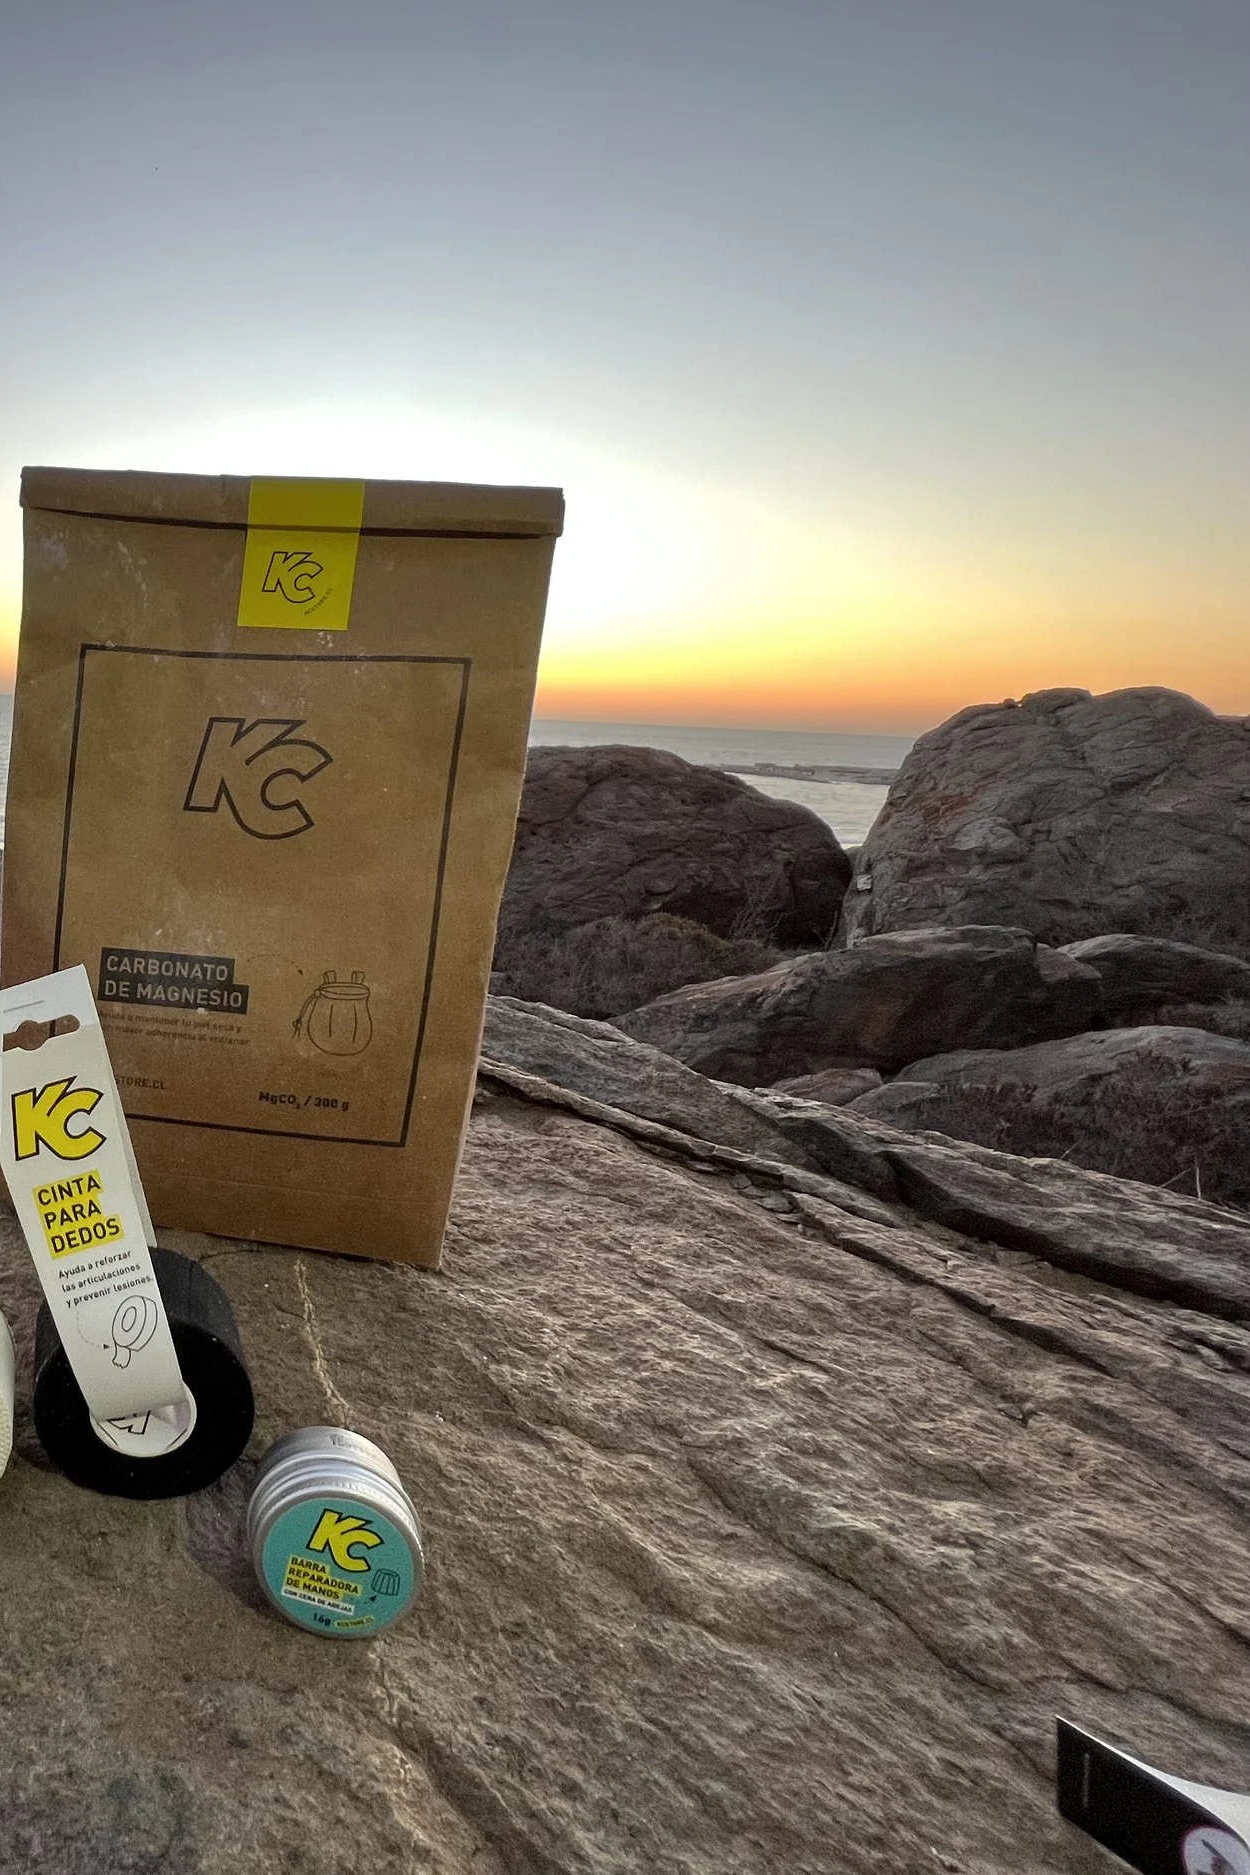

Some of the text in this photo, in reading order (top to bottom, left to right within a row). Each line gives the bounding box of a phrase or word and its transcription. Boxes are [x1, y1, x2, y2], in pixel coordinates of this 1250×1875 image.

[261, 551, 324, 604] KC
[183, 716, 334, 840] KC
[106, 955, 229, 981] CARBONATO
[104, 980, 242, 1008] DE MAGNESIO
[11, 1075, 107, 1161] KC
[303, 1095, 311, 1107] /
[314, 1097, 338, 1109] 300
[341, 1101, 350, 1113] g
[37, 1174, 101, 1206] CINTA
[43, 1199, 102, 1230] PARA
[51, 1218, 120, 1254] DEDOS
[58, 1264, 86, 1279] Ayuda
[95, 1251, 131, 1268] reforzar
[62, 1263, 141, 1293] las articulaciones
[66, 1275, 153, 1308] y prevenir lesiones.
[305, 1508, 384, 1573] KC
[291, 1557, 326, 1574] BARRA
[286, 1577, 340, 1599] DE MANOS
[288, 1567, 358, 1594] REPARADORA
[284, 1588, 352, 1613] CON CERA DE ABEJAS
[313, 1612, 331, 1627] 16g
